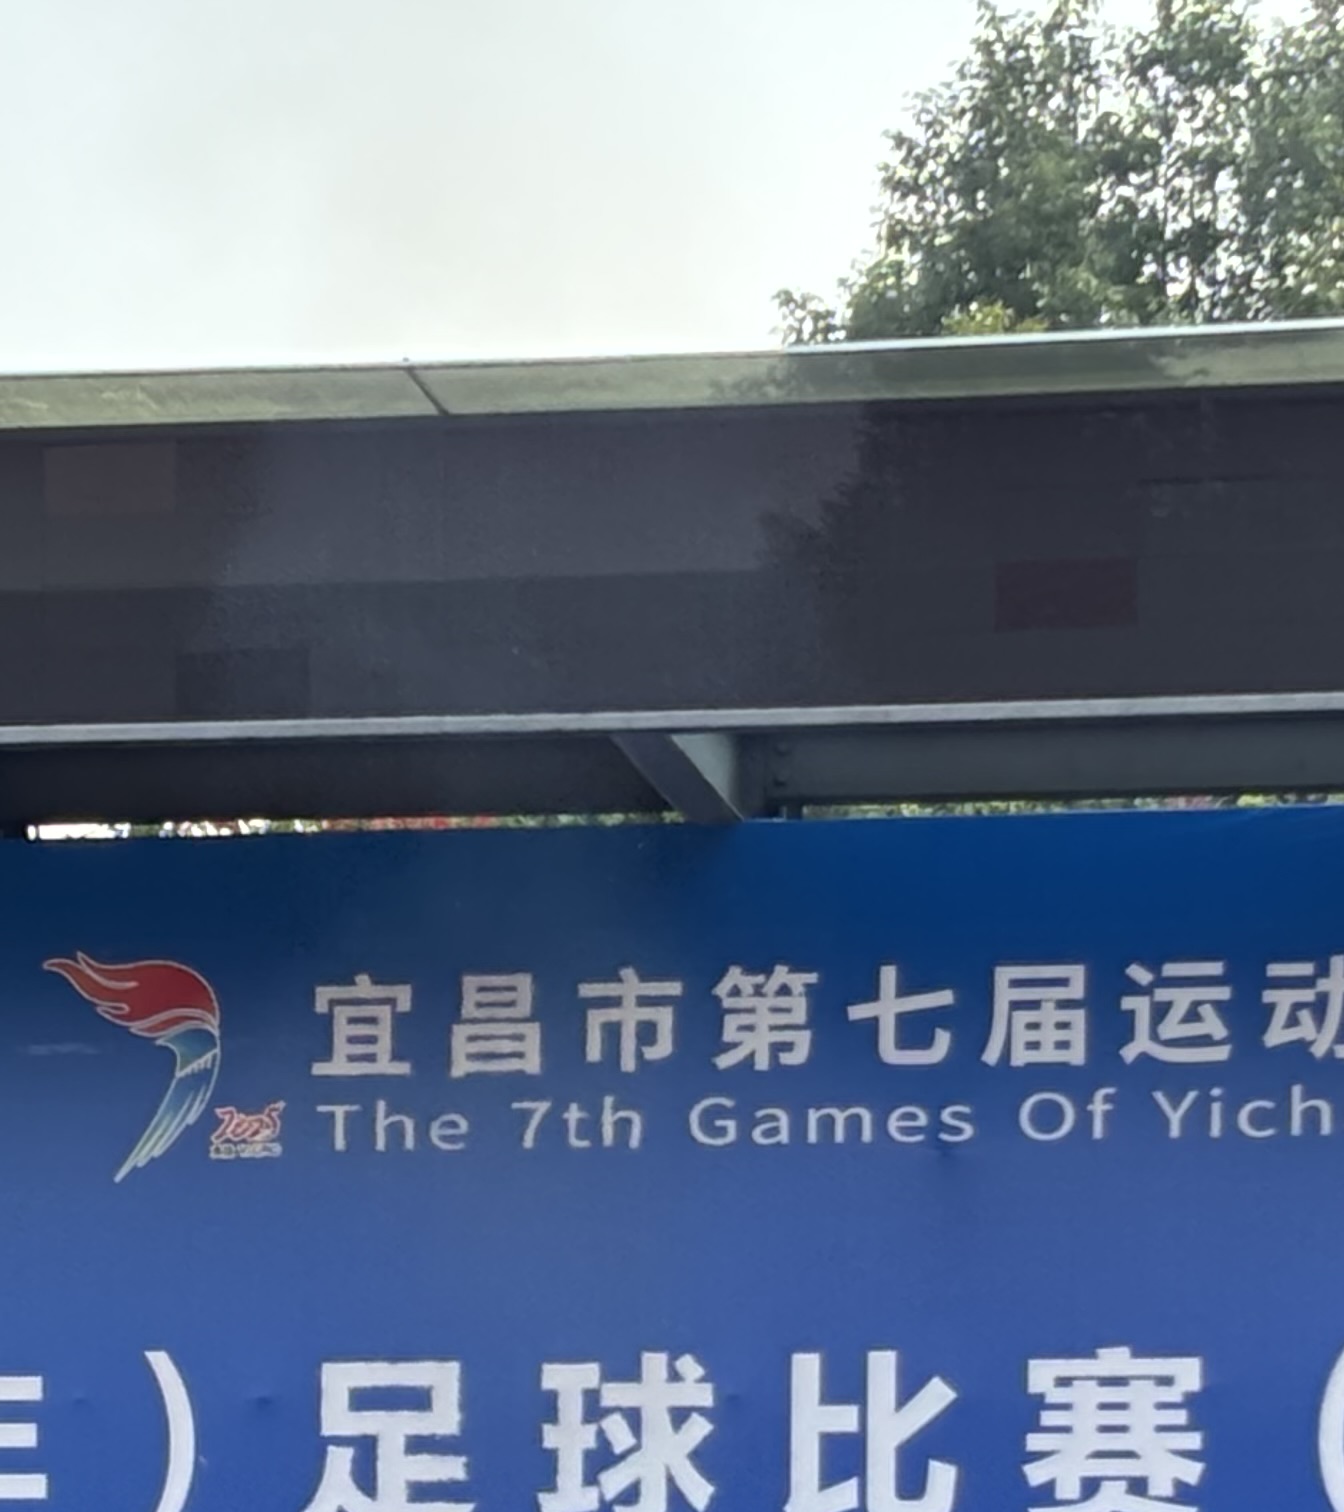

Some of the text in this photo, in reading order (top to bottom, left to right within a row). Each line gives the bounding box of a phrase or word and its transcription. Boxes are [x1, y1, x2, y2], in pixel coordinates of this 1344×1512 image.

[316, 1099, 469, 1152] The
[511, 1095, 643, 1150] 7th
[689, 1096, 975, 1147] Games
[1019, 1086, 1117, 1142] Of
